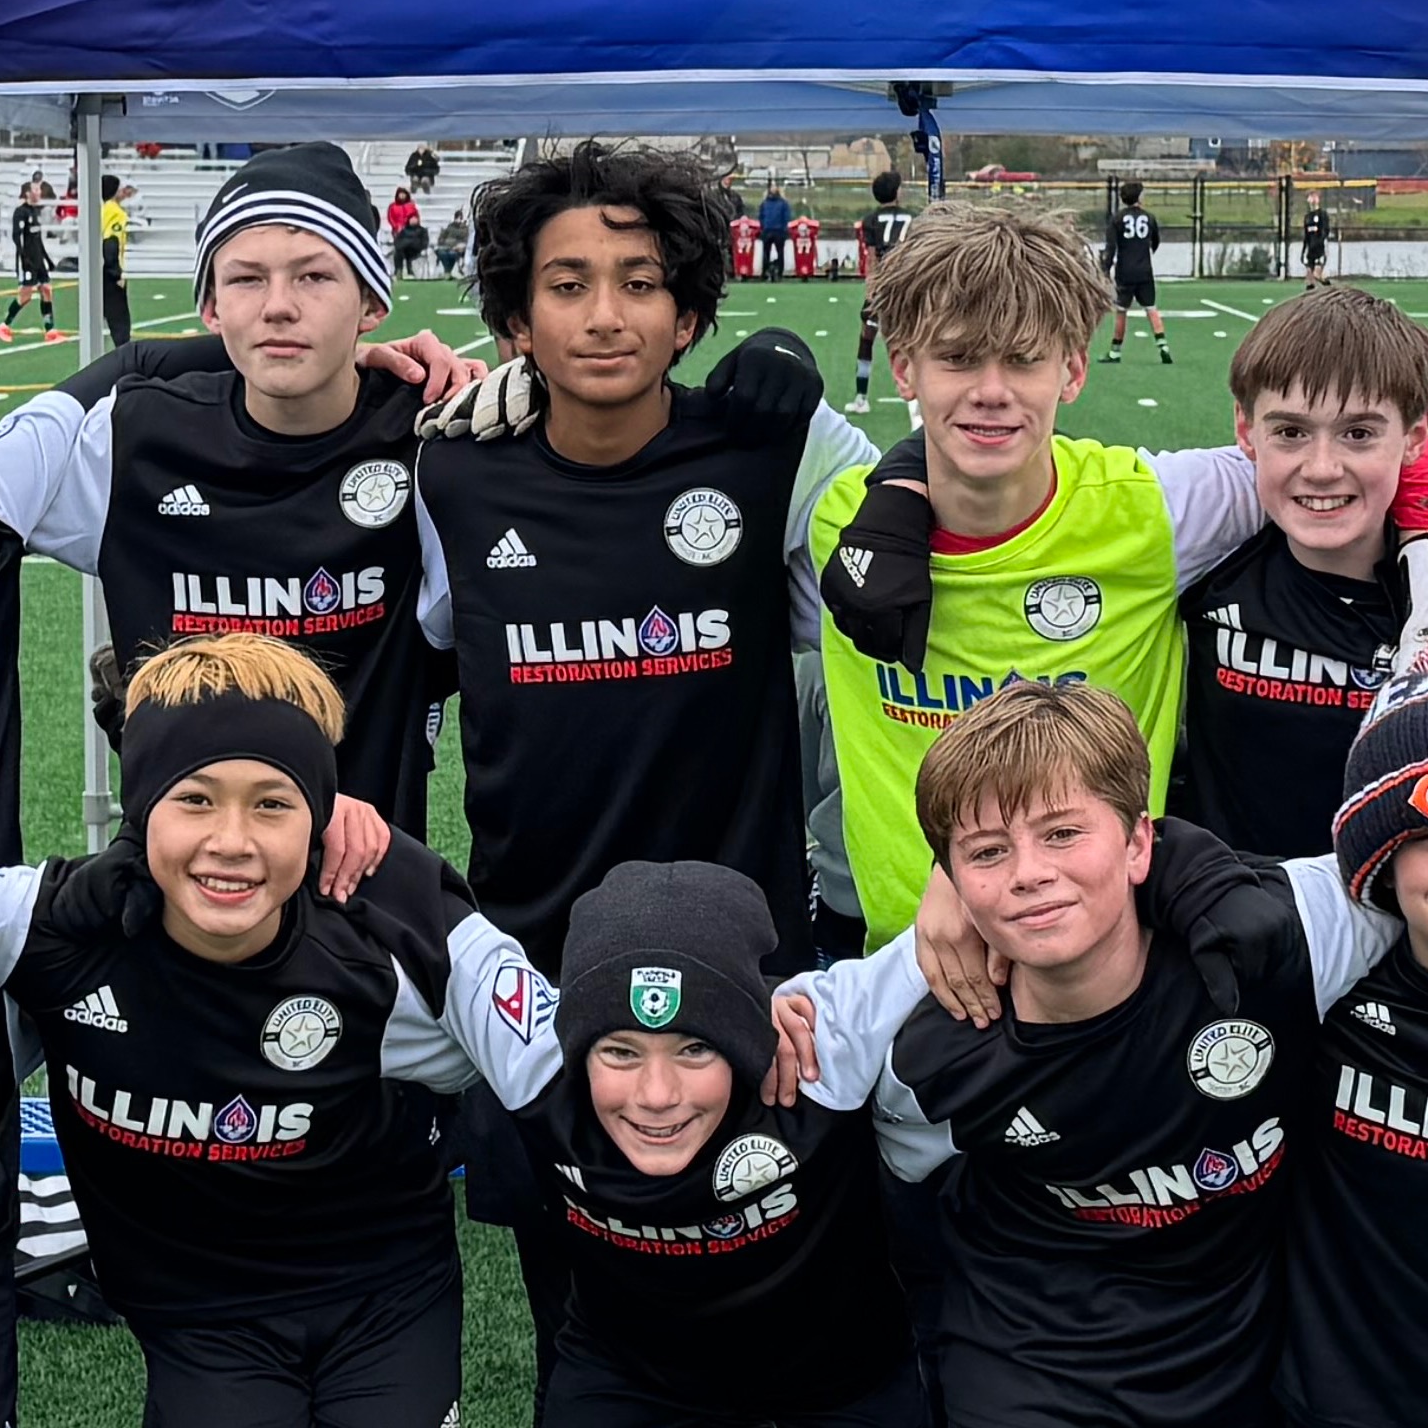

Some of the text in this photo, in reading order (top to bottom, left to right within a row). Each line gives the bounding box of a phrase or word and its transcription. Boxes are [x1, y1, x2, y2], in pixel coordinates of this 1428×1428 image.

[878, 215, 912, 243] 77
[1123, 214, 1149, 239] 36
[158, 502, 211, 516] adidas
[487, 553, 538, 569] adidas
[172, 613, 300, 637] RESTORATION
[509, 648, 733, 684] RESTORATION SERVICES
[64, 1007, 128, 1033] adidas
[273, 999, 337, 1027] UNITED ELITE
[1193, 1024, 1262, 1063] UNITED ELITE
[719, 1139, 780, 1182] UNITED ELITE
